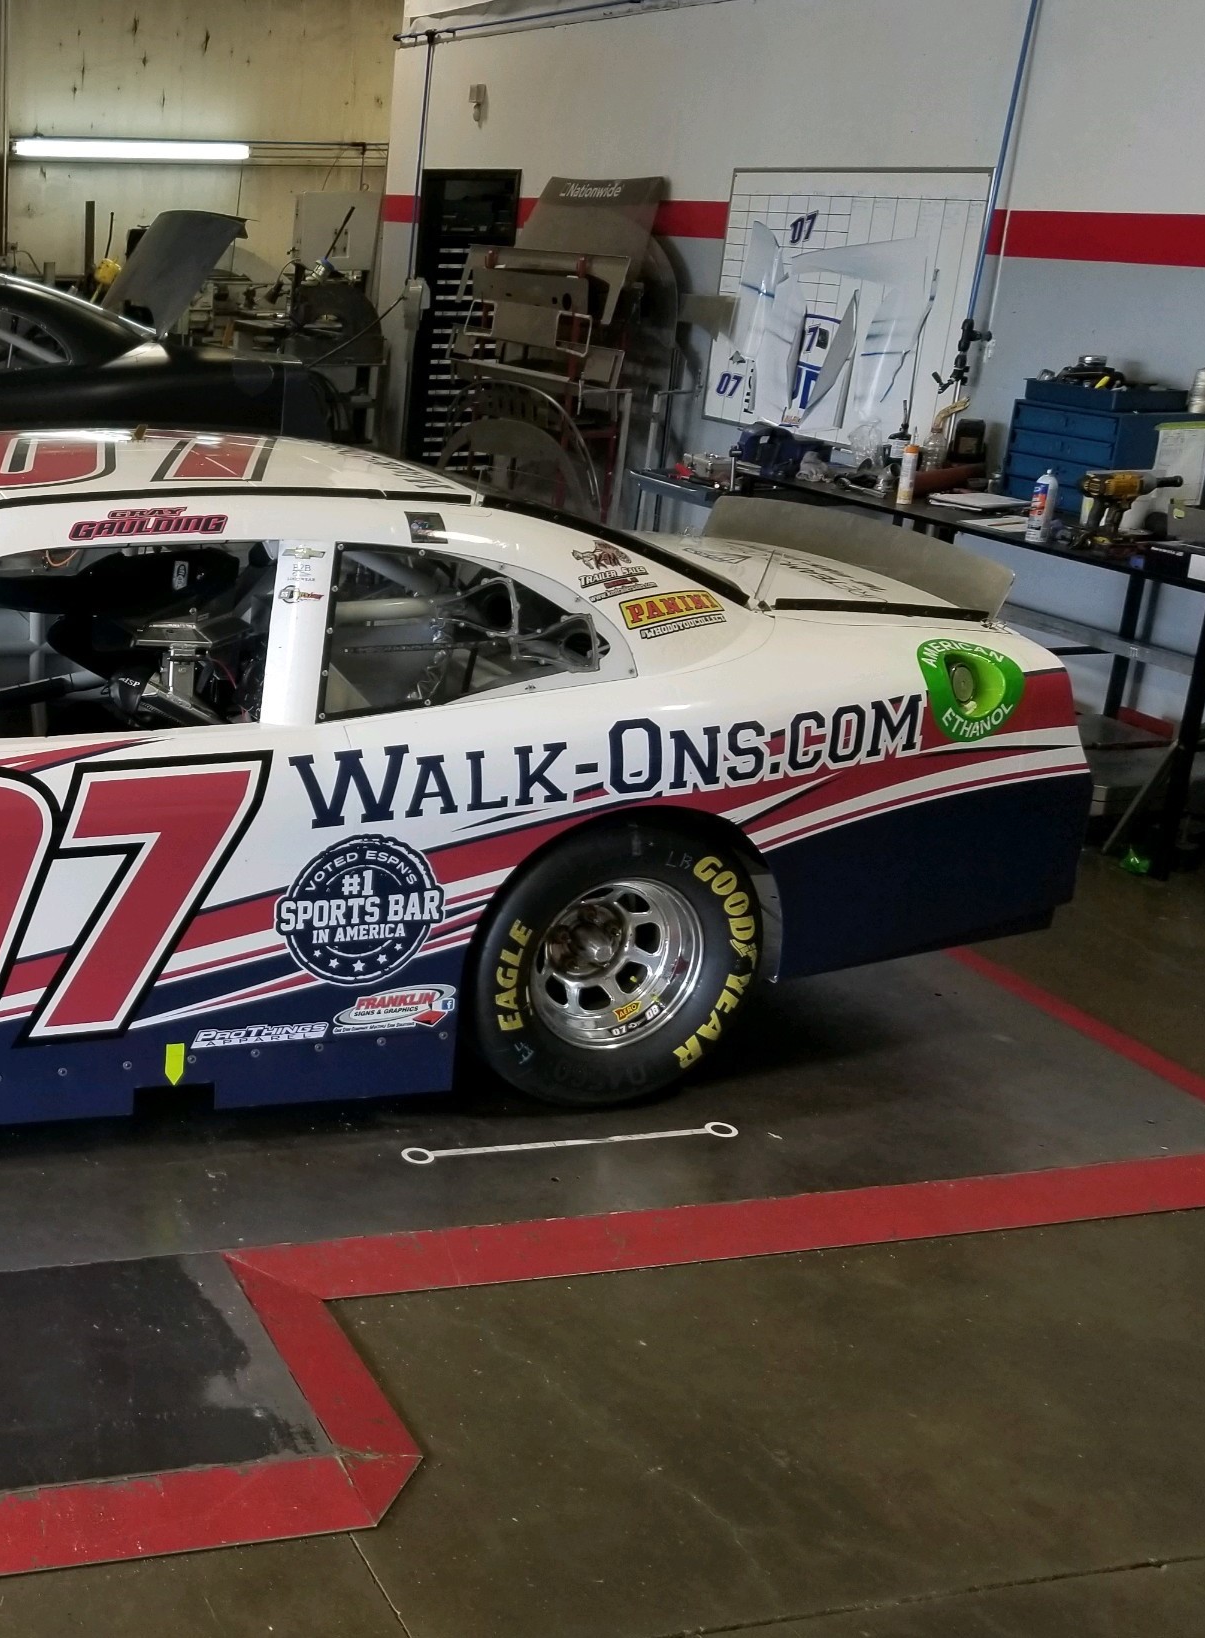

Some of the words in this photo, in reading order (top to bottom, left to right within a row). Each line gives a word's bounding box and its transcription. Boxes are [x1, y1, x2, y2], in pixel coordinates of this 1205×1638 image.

[567, 182, 623, 198] Nationwide
[790, 210, 820, 246] 07
[716, 371, 744, 398] 07
[108, 506, 188, 519] GRAY
[69, 515, 228, 541] GAULDING
[578, 570, 617, 588] TRAILER
[626, 595, 720, 624] PANINI
[921, 641, 1005, 669] AMERICAN
[941, 703, 1014, 738] ETHANOL
[305, 852, 359, 892] VOTED
[365, 850, 418, 886] ESPN'S
[341, 869, 374, 896] #1
[280, 896, 381, 932] SPORTS
[386, 890, 441, 922] BAR
[312, 928, 330, 944] IN
[334, 923, 406, 942] AMERICA
[495, 918, 534, 1032] EAGLE
[355, 992, 437, 1010] FRANKLIN
[383, 1006, 419, 1014] GRAPHICS
